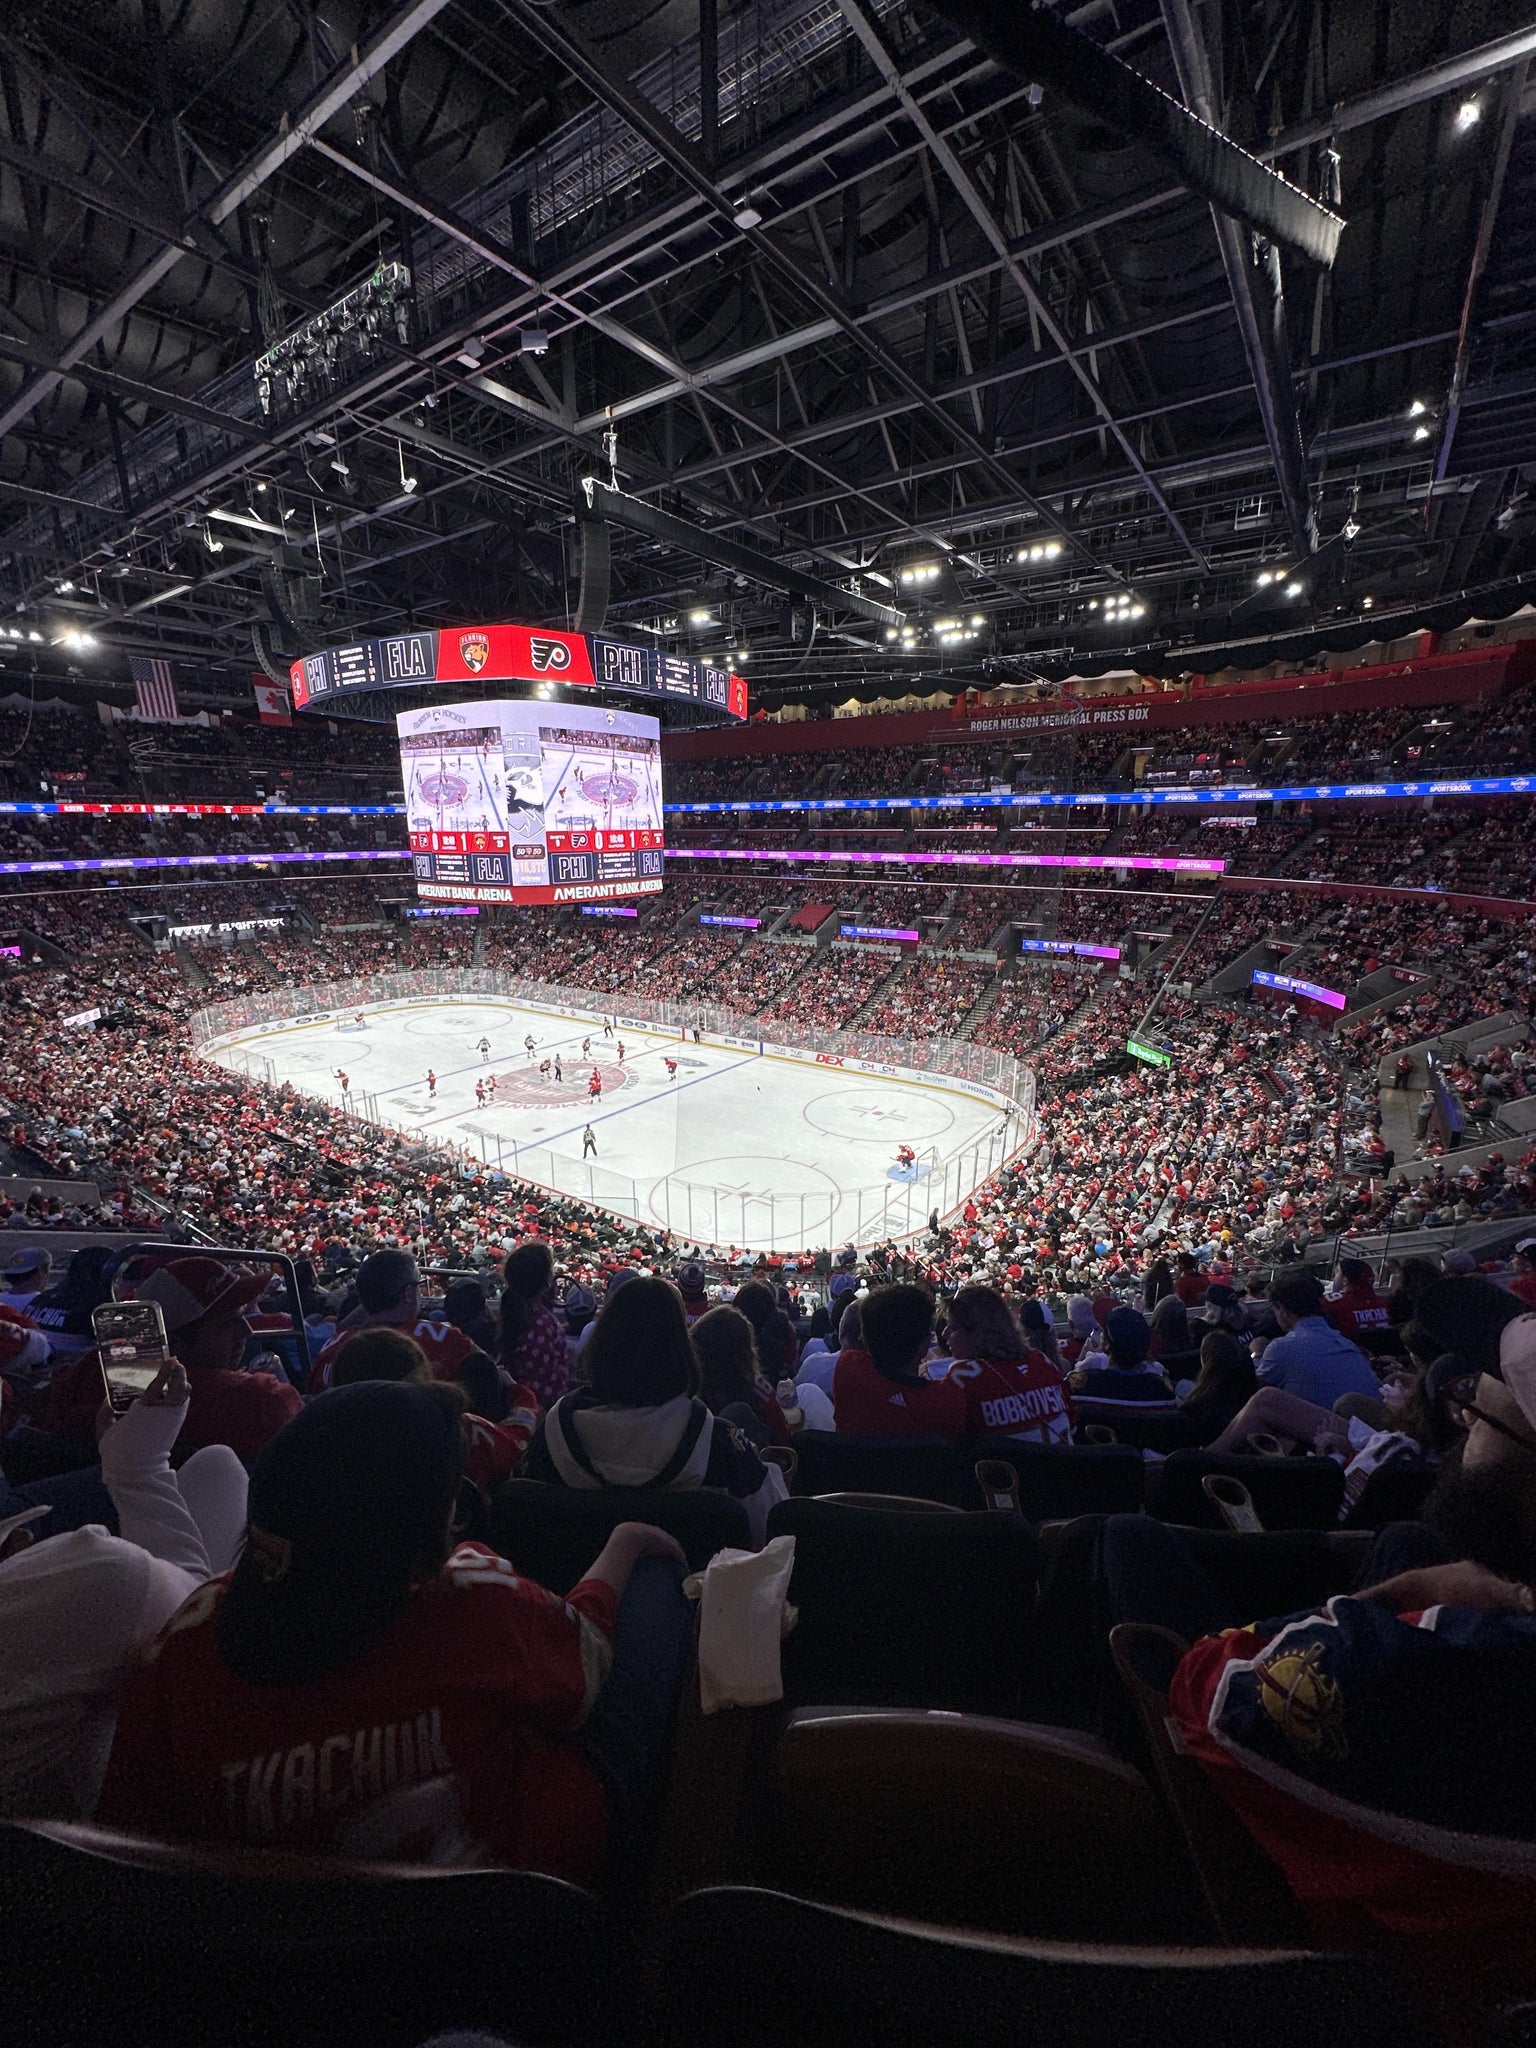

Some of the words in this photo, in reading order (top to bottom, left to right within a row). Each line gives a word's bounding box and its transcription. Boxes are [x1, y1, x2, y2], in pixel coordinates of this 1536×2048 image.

[387, 639, 426, 678] FLA
[604, 645, 642, 685] PHI
[306, 656, 327, 693] PHI
[706, 669, 726, 704] FLA
[970, 719, 999, 732] ROGER
[1000, 716, 1039, 730] NEILSON
[1042, 713, 1092, 728] MEMORIAL
[1094, 710, 1126, 724] PRESS
[1128, 708, 1149, 720] BOX
[1344, 788, 1386, 796] SPORTSBOOK
[1430, 784, 1472, 792] SPORTSBOOK
[460, 833, 467, 852] 1
[630, 831, 635, 848] 1
[415, 856, 431, 877] PHI
[478, 858, 504, 880] FLA
[558, 856, 588, 880] PHI
[642, 852, 660, 874] FLA
[452, 886, 476, 900] BANK
[476, 888, 514, 902] ARENA
[554, 884, 615, 901] AMERANT
[616, 882, 640, 896] BANK
[640, 879, 664, 892] ARENA
[219, 921, 256, 932] FLIGHT
[408, 996, 439, 1004] AutoNation
[816, 1054, 846, 1066] DEX
[967, 1085, 994, 1099] HONDA
[1352, 1308, 1389, 1324] TKACHUK
[980, 1384, 1068, 1427] BOBROVSK
